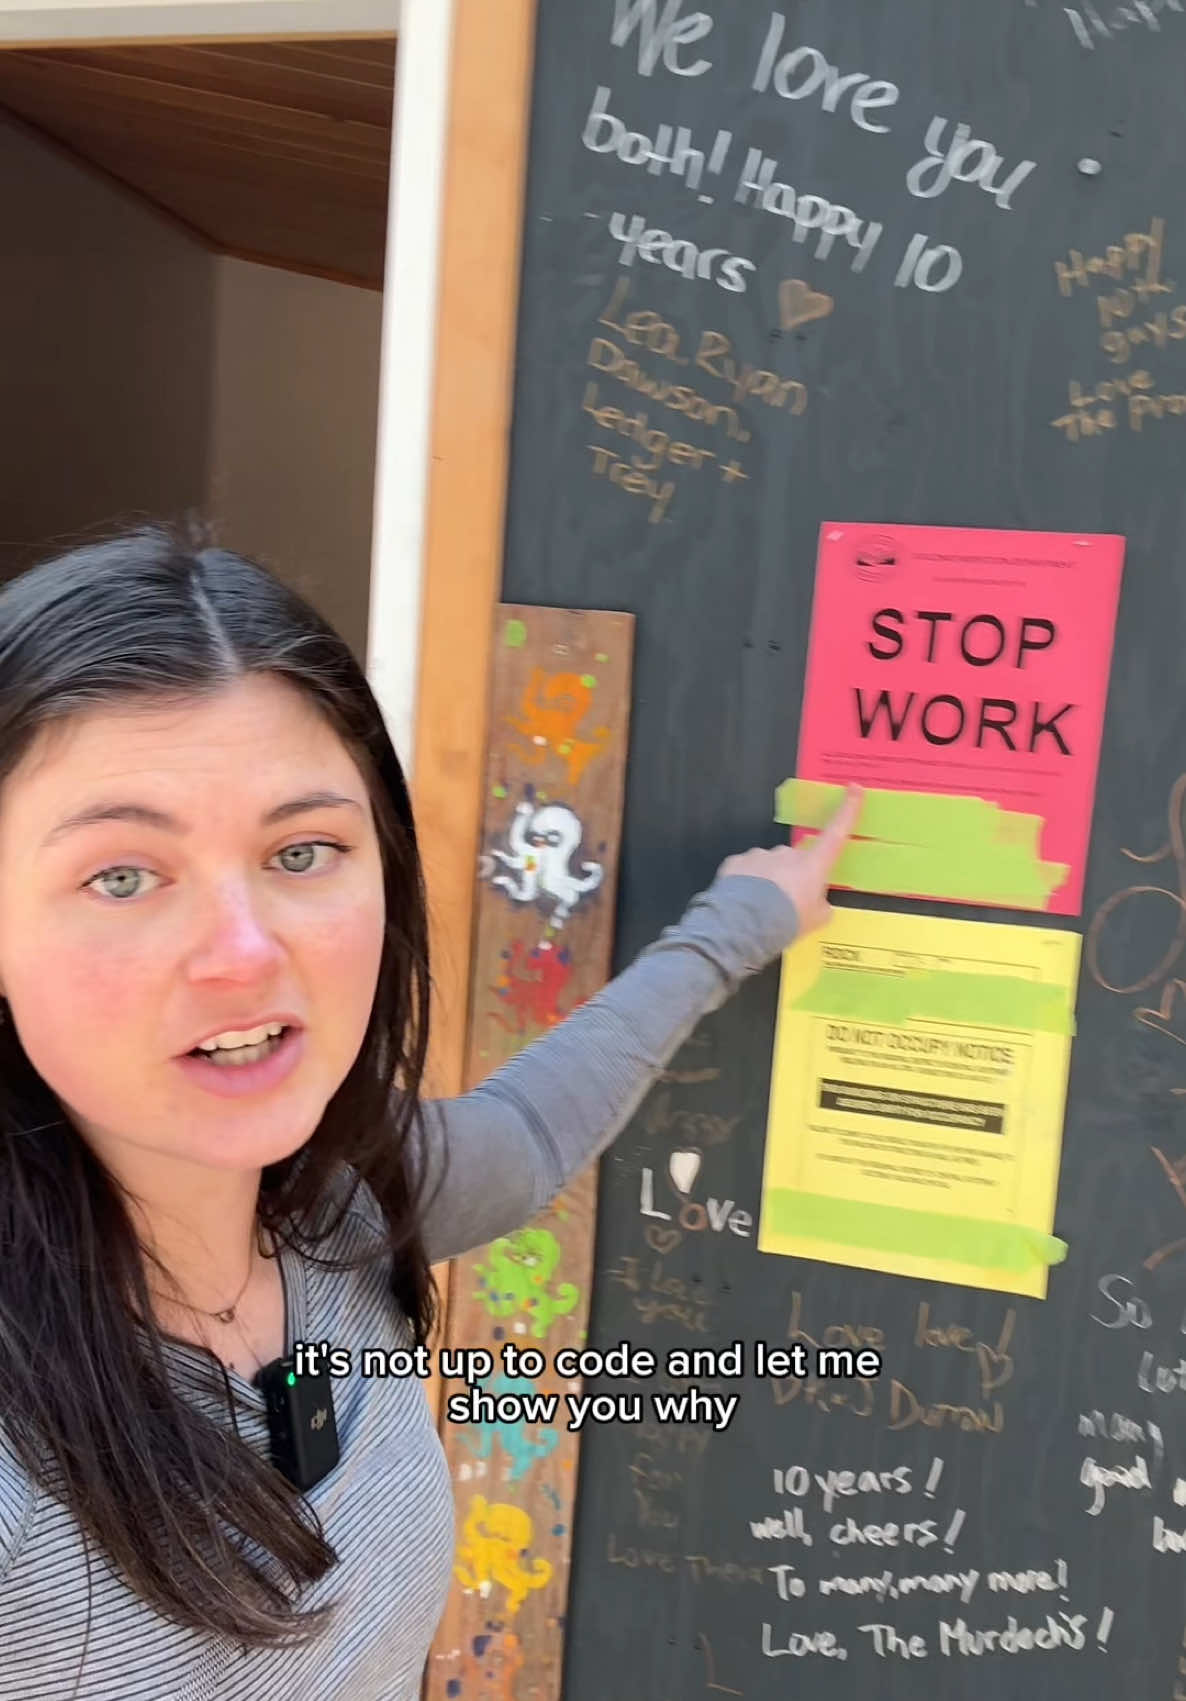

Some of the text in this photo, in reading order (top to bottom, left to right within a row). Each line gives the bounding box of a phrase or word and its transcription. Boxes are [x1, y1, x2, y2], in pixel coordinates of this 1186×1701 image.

[610, 0, 1037, 210] We love you
[733, 148, 883, 273] Happy
[895, 233, 963, 293] 10
[608, 211, 757, 293] years
[866, 607, 1057, 669] STOP
[852, 687, 1077, 756] WORK
[851, 1026, 885, 1048] NOT
[1087, 1273, 1153, 1329] So
[774, 1466, 809, 1496] 10
[830, 1509, 966, 1554] cheers!
[768, 1564, 806, 1601] To
[857, 1624, 928, 1659] The
